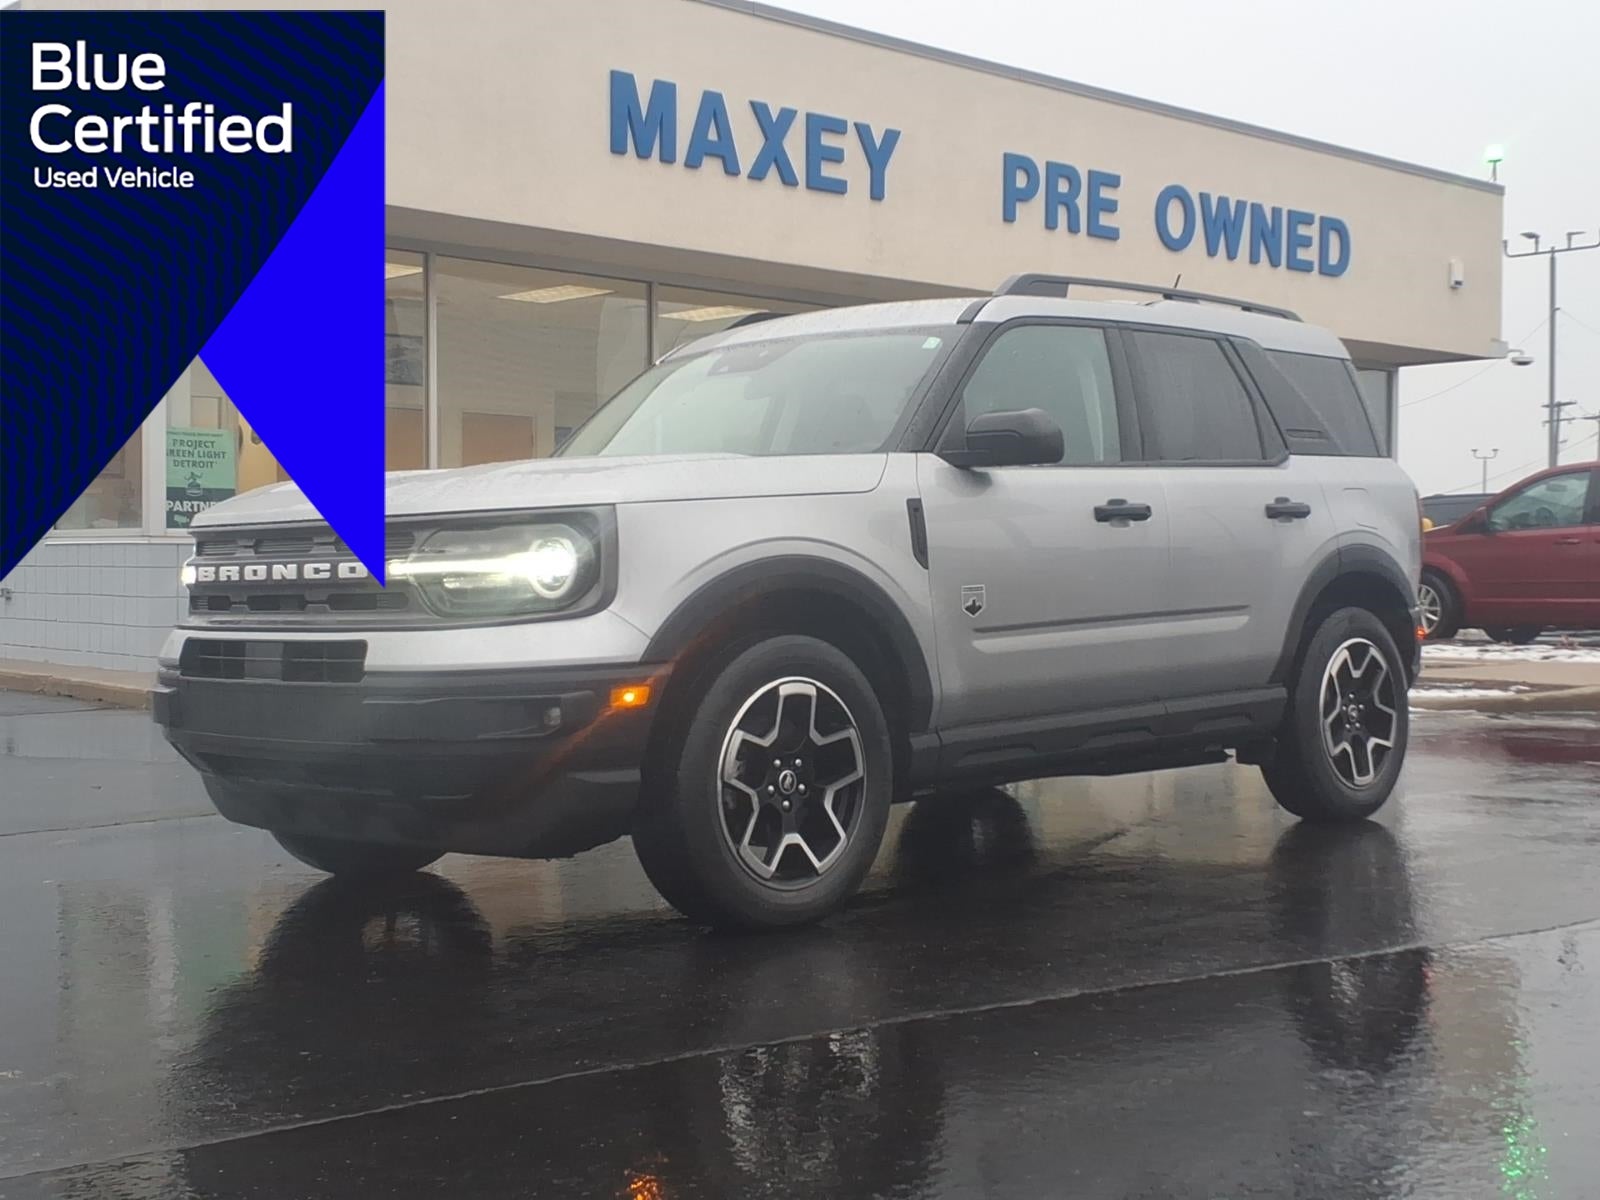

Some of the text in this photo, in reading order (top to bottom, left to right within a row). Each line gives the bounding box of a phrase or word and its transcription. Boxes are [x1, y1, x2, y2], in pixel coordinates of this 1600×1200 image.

[609, 69, 1351, 277] MAXEY PRE OWNED
[172, 439, 216, 449] PROJECT
[198, 450, 226, 460] LIGHT
[173, 459, 214, 469] DETROIT
[197, 562, 368, 582] BRONCO
